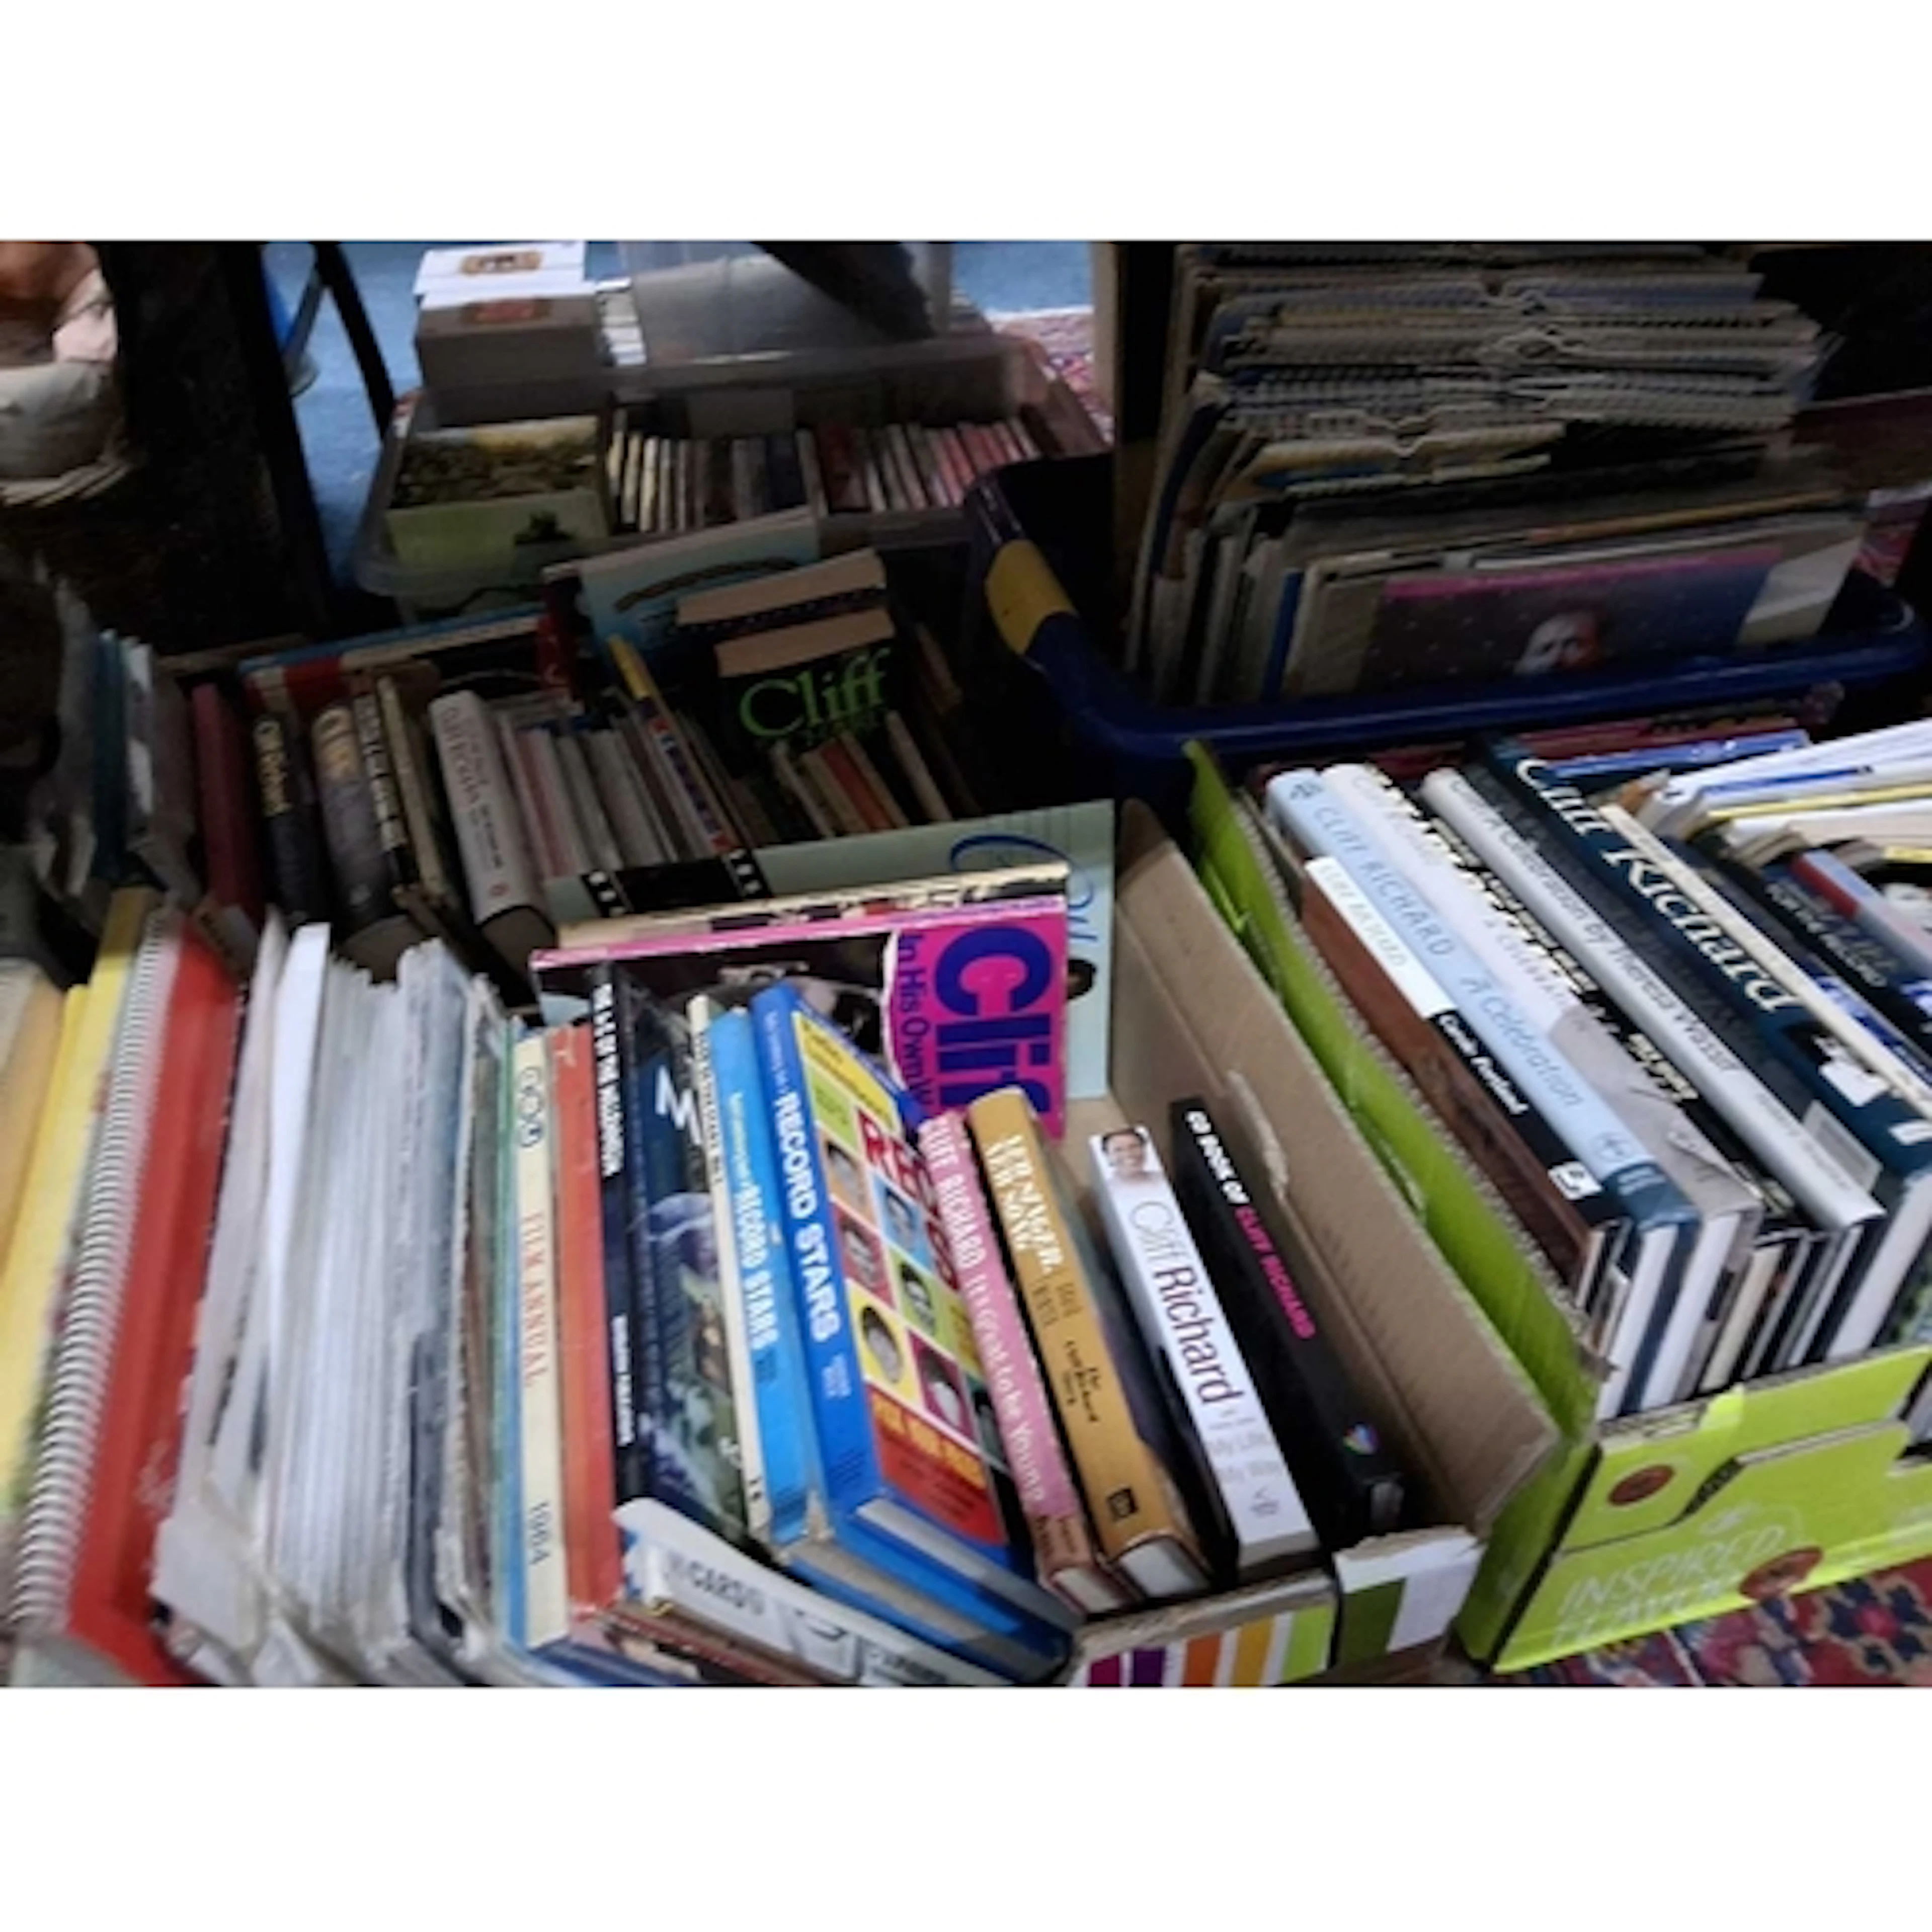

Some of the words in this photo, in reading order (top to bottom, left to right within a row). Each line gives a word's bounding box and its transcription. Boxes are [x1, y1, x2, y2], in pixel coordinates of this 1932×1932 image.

[740, 648, 891, 736] Cliff
[1516, 759, 1608, 836] Cliff
[1600, 847, 1800, 1012] Richard
[898, 968, 927, 1012] His
[899, 934, 924, 962] In
[1360, 860, 1455, 956] RICHARD
[1480, 996, 1585, 1106] Celebration
[901, 1017, 929, 1079] Own
[935, 926, 1053, 1112] Clif
[775, 1090, 819, 1220] RECORD
[520, 1212, 544, 1268] FILM
[735, 1184, 769, 1269] RECORD
[1130, 1200, 1191, 1264] Cliff
[1200, 1134, 1234, 1180] BOOK
[1234, 1205, 1272, 1253] CLIFF
[1260, 1253, 1316, 1341] RICHARD
[744, 1269, 779, 1350] STARS
[795, 1222, 841, 1343] STARS
[523, 1280, 547, 1387] ANNUAL
[936, 1173, 987, 1269] RICHARD
[971, 1308, 1009, 1361] Great
[1009, 1421, 1044, 1501] Young
[1152, 1264, 1245, 1403] Richard
[528, 1501, 551, 1565] 1964
